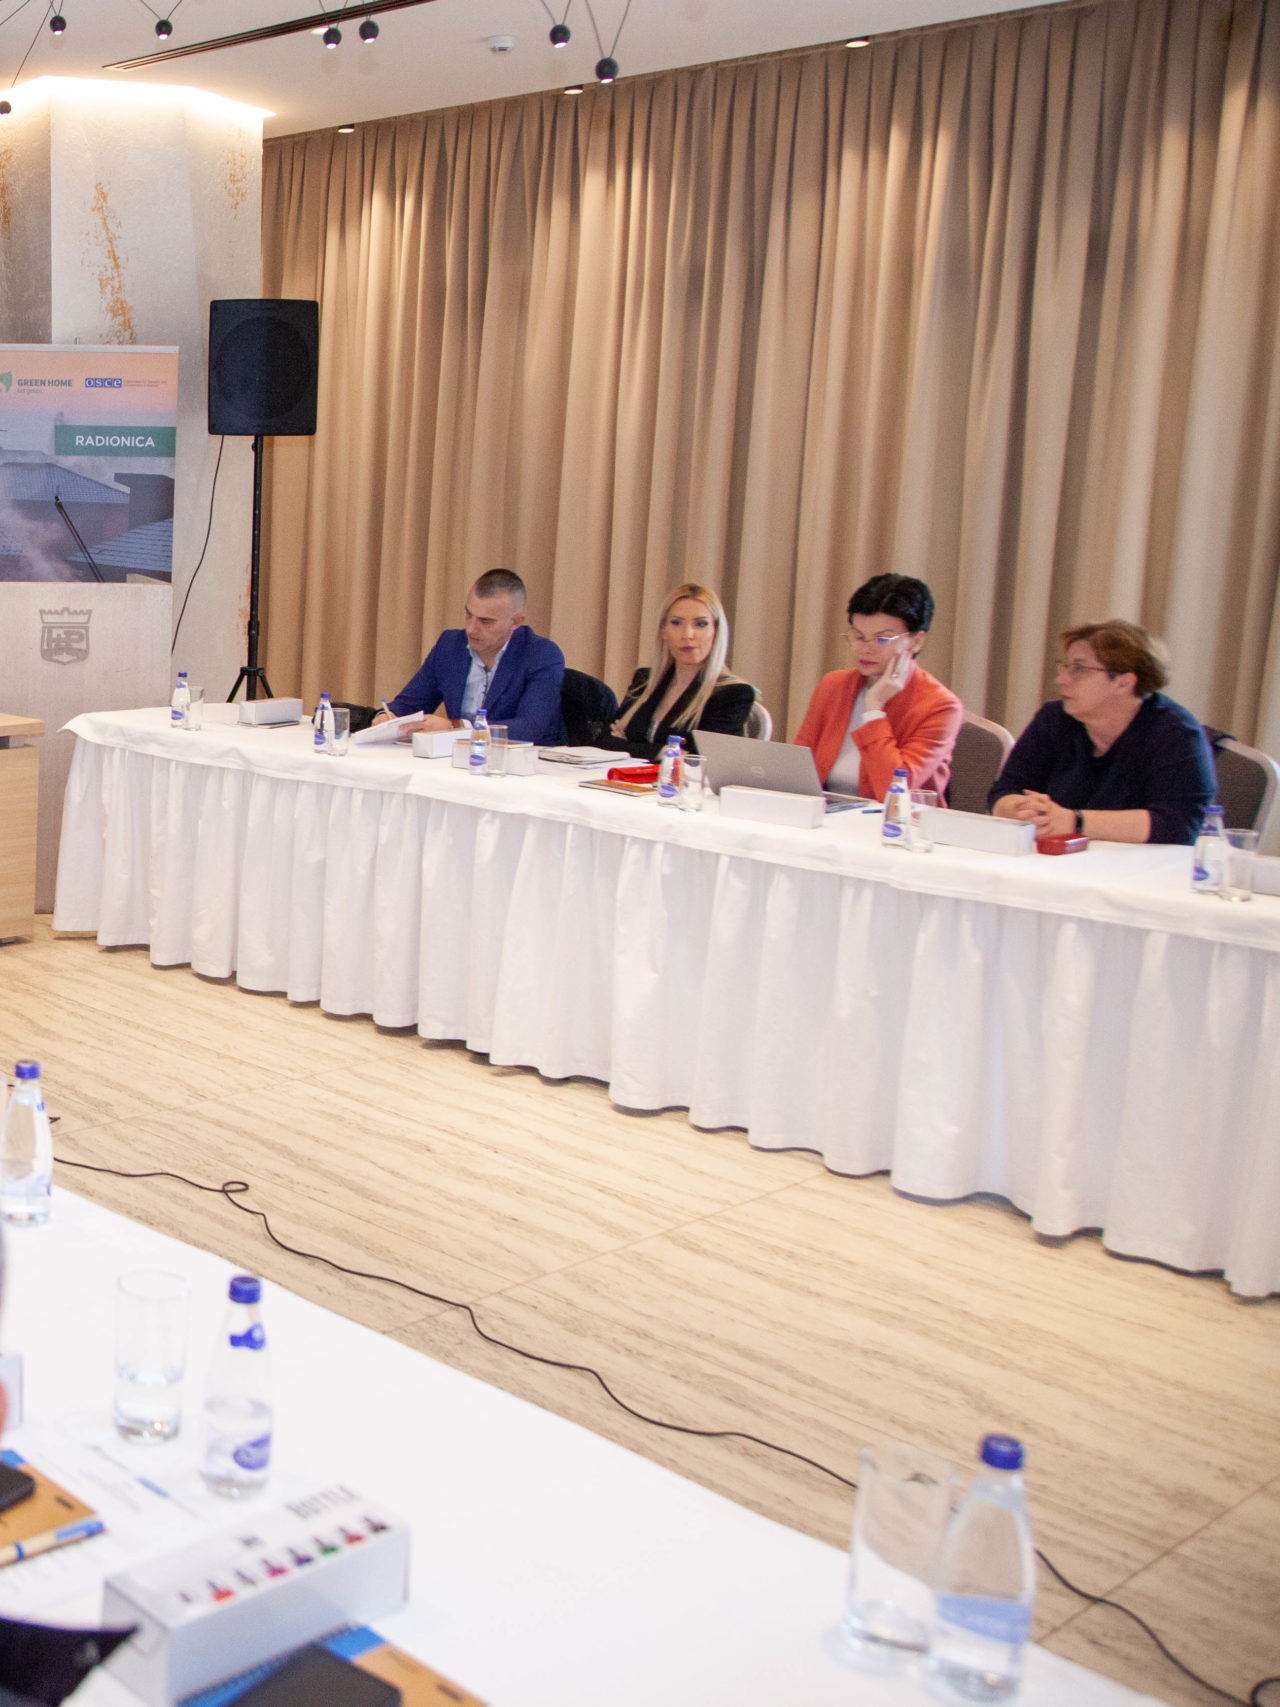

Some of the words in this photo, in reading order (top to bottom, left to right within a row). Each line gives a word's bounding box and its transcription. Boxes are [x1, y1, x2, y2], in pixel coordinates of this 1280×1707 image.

[17, 379, 46, 388] GREEN
[48, 379, 73, 388] HOME
[75, 435, 155, 448] RADIONICA
